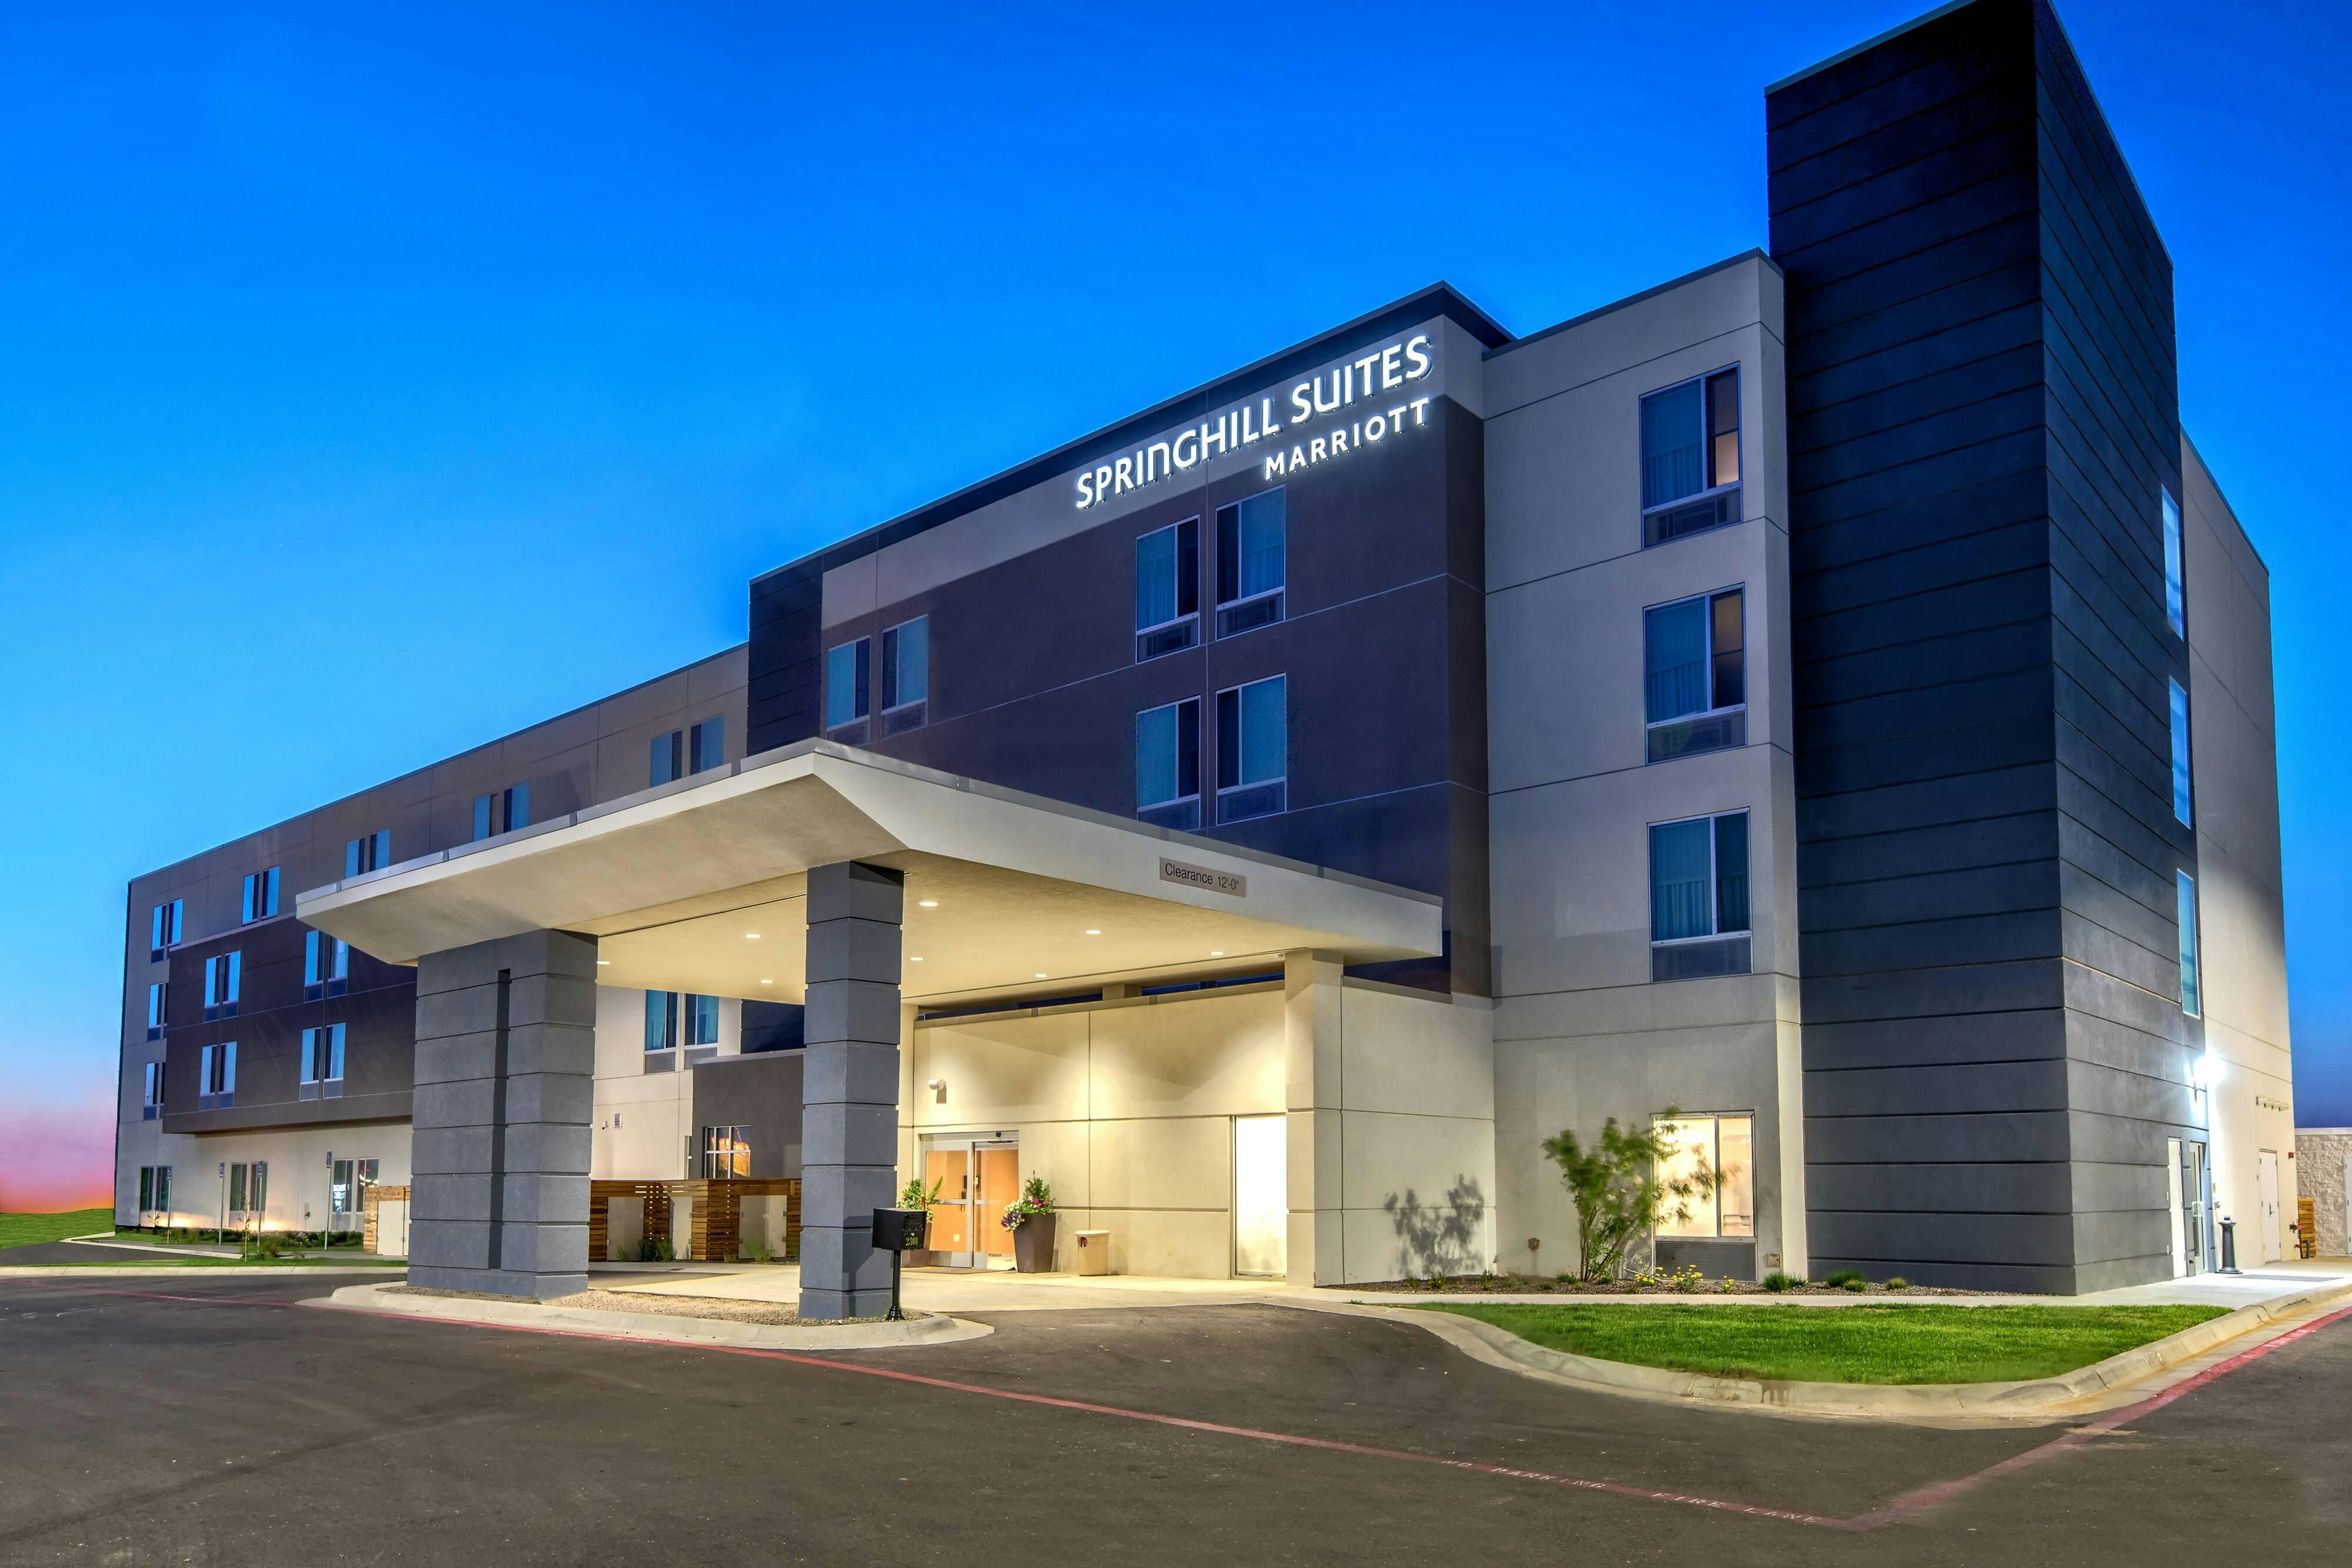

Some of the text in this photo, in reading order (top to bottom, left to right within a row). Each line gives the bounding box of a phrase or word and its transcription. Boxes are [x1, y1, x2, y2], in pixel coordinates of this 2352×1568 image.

[1076, 336, 1431, 509] SPRINGHILL SUITES
[1265, 397, 1429, 480] MARRIOTT
[1165, 862, 1213, 884] Clearance
[906, 1236, 918, 1246] 2301
[1491, 1467, 1606, 1487] PARKING
[1652, 1493, 1727, 1507] FIRE
[1743, 1507, 1822, 1523] LANE
